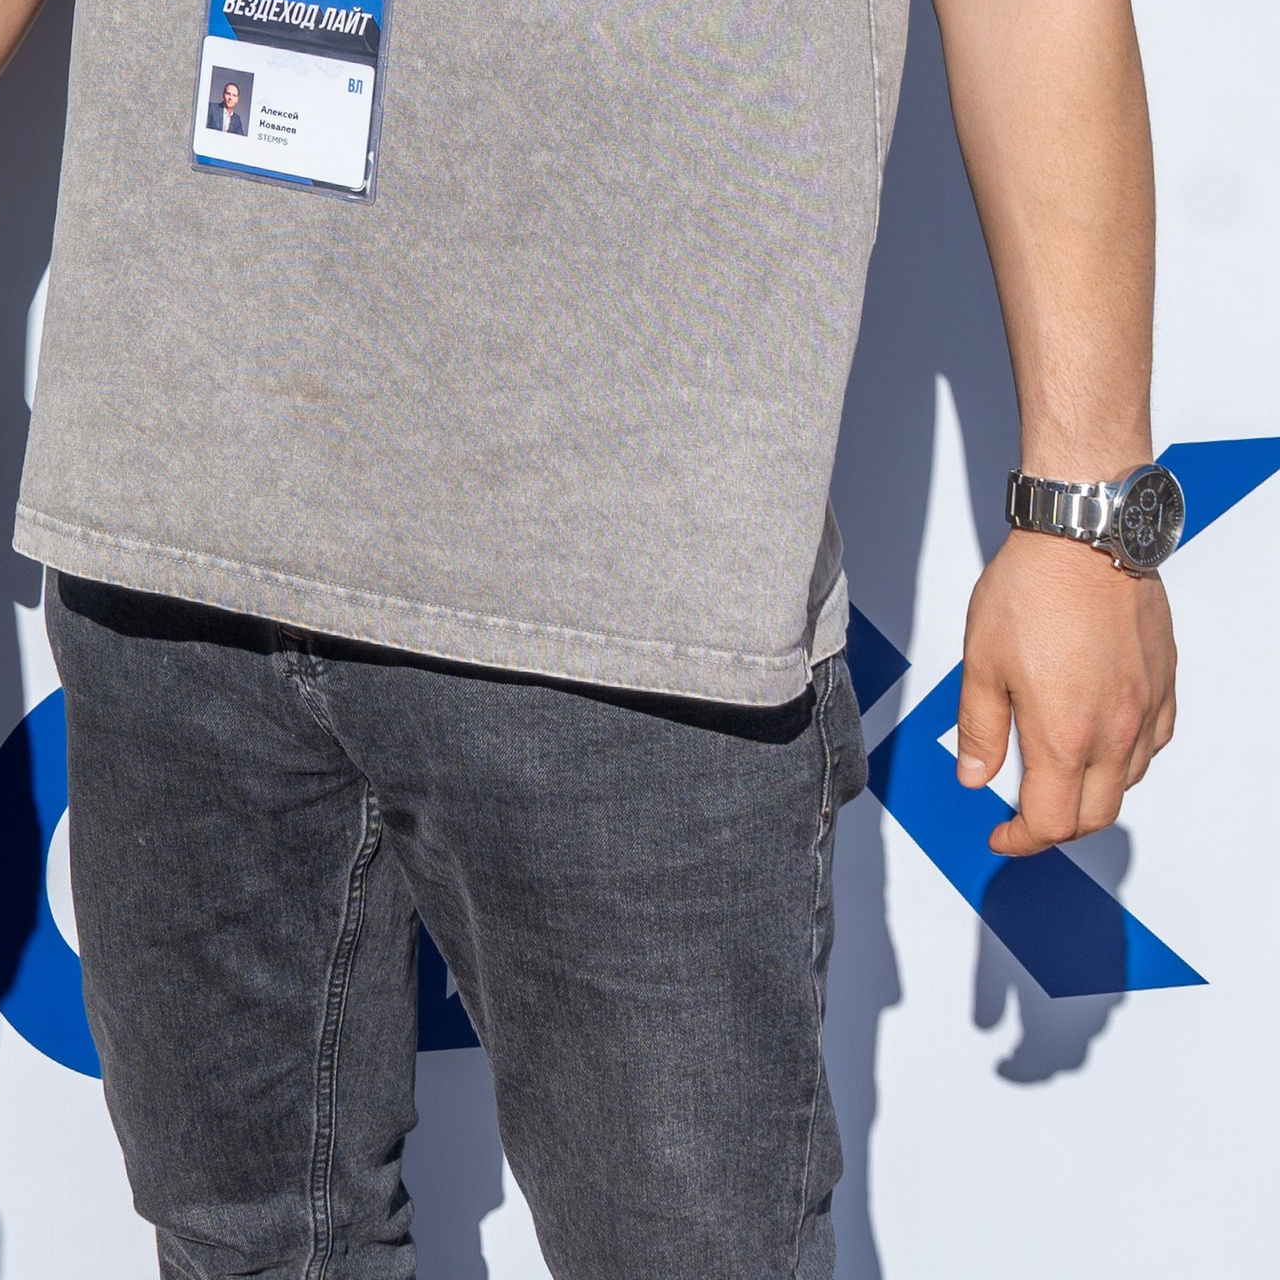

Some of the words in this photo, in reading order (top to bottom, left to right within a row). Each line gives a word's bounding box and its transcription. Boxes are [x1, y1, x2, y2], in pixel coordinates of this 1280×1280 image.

[319, 6, 373, 37] ЛАЙТ
[347, 78, 364, 95] ВЛ
[260, 105, 299, 121] Алексей
[259, 119, 297, 135] Ковалев
[257, 133, 289, 146] STEMPS
